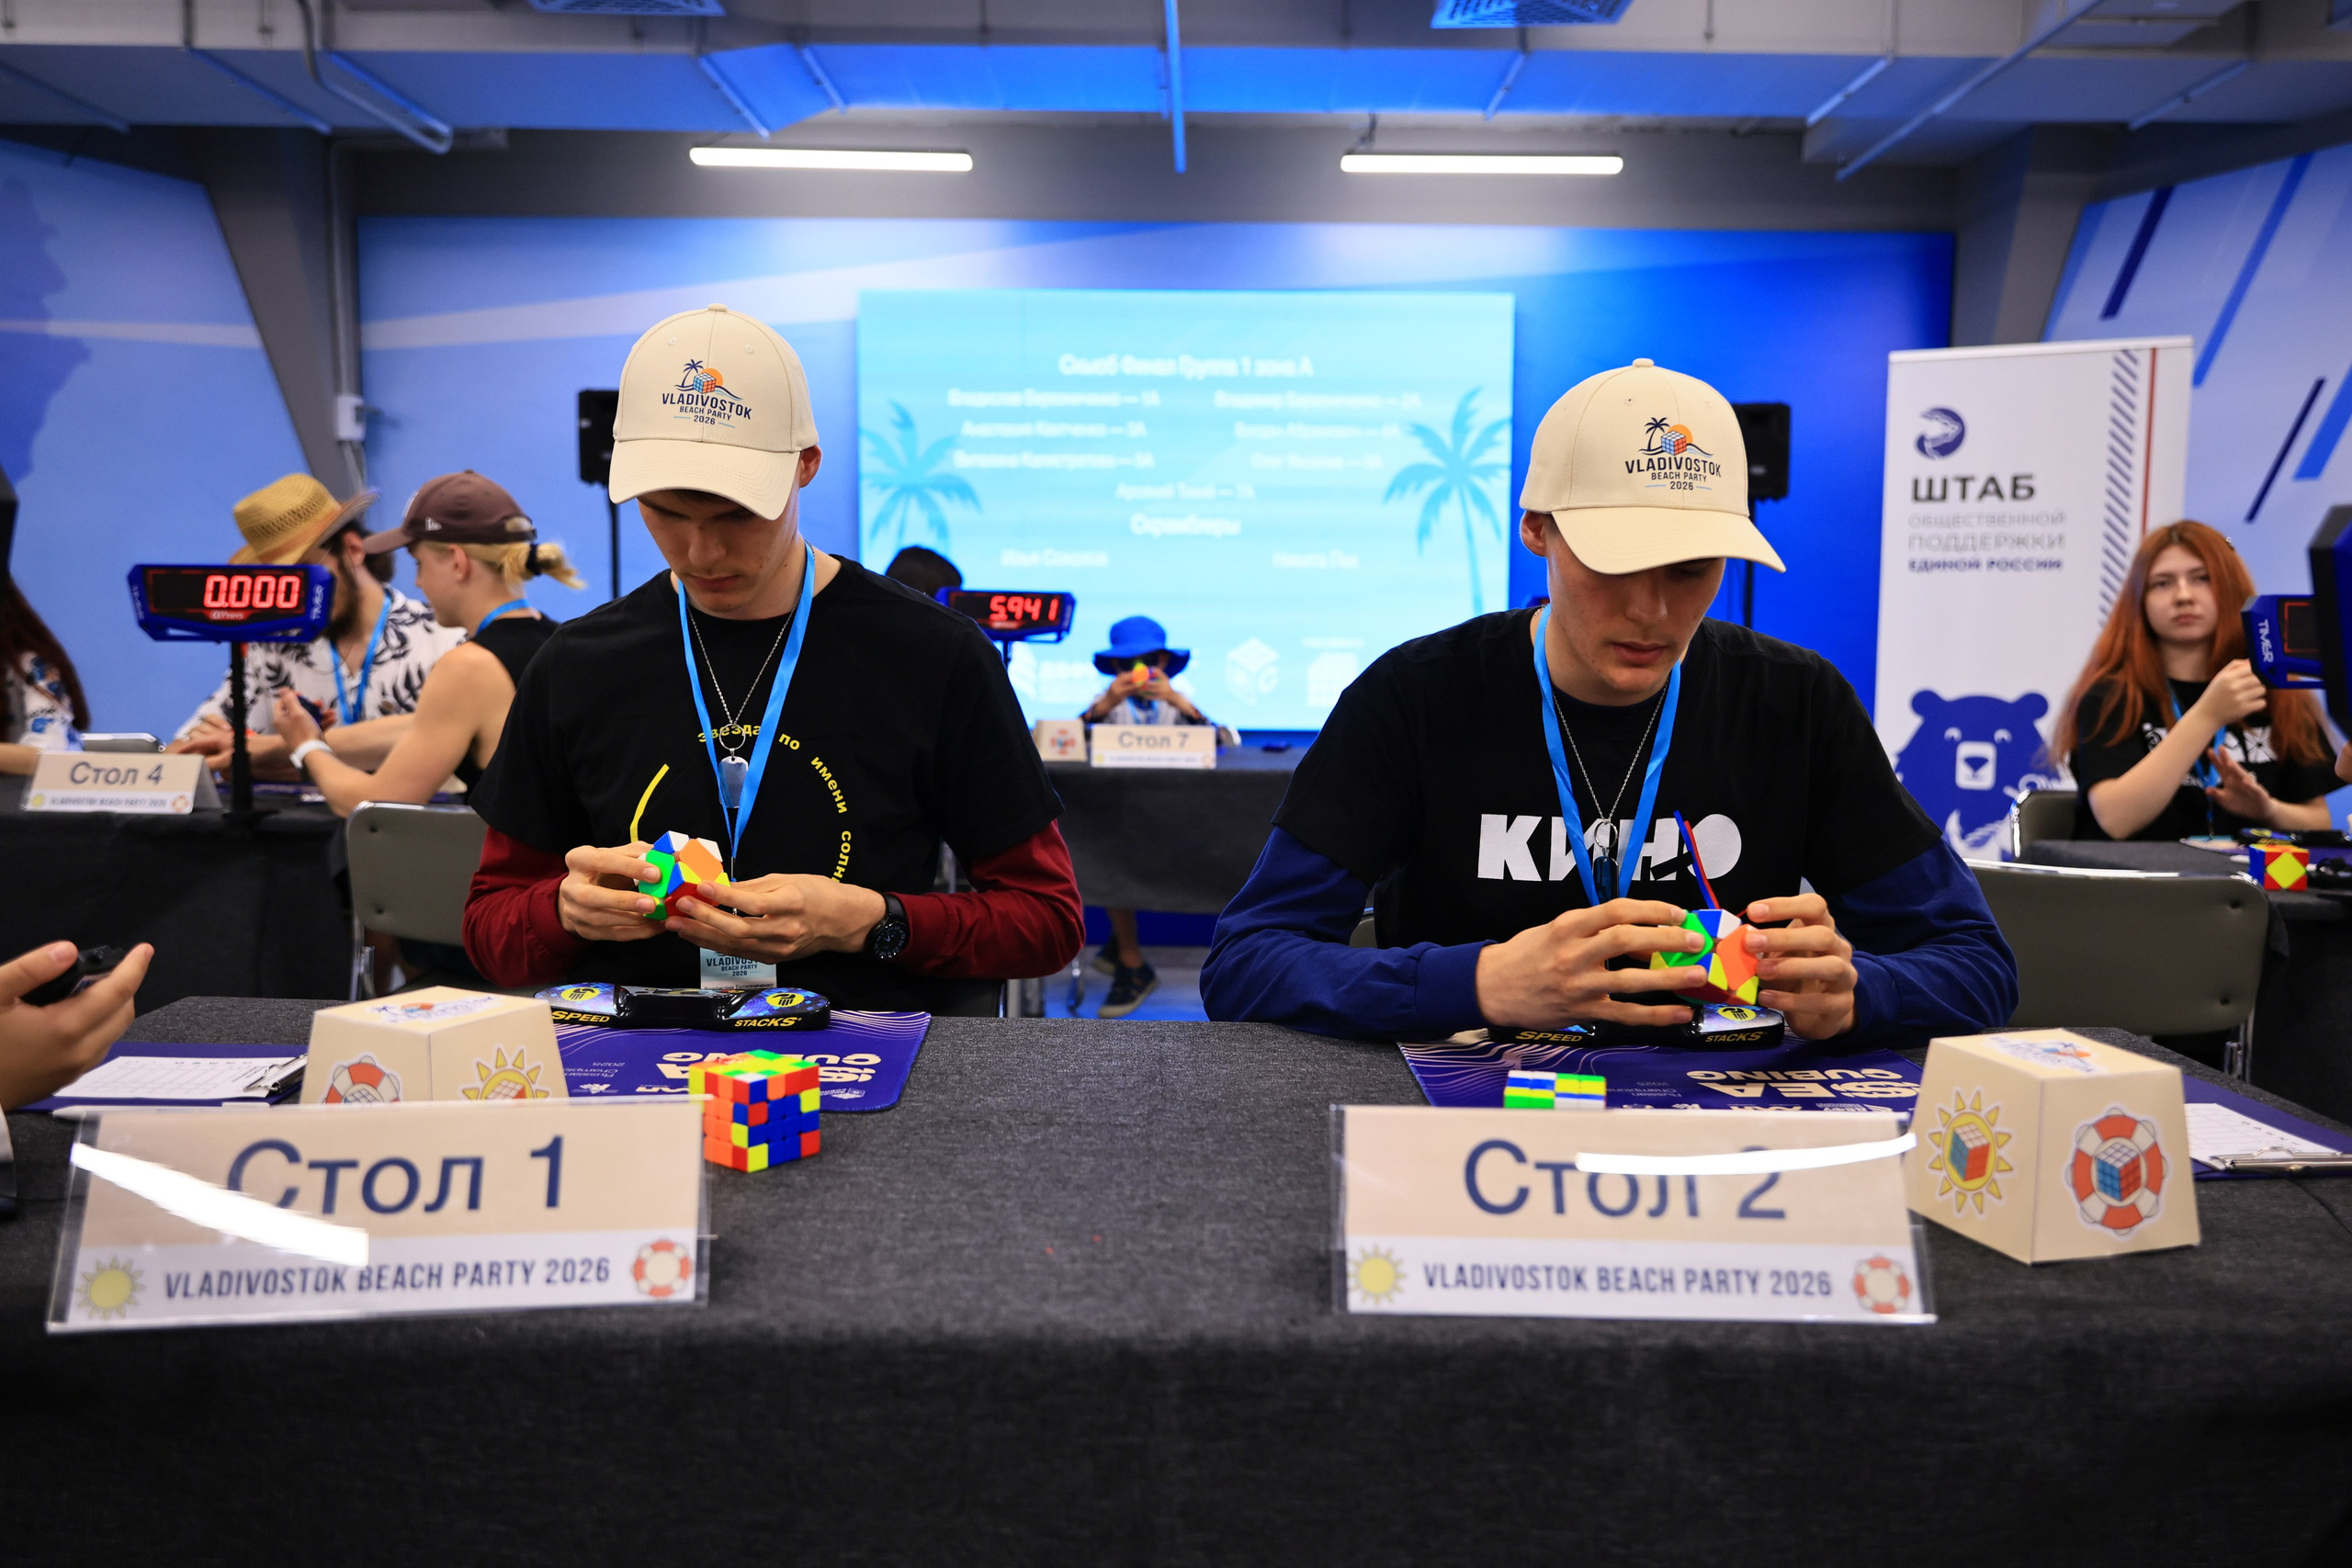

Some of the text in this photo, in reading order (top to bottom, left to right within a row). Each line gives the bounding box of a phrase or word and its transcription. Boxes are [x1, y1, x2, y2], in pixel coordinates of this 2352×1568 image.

[662, 393, 752, 420] VLADIVOSTOK
[707, 409, 731, 421] PARTY
[694, 415, 716, 424] 2026
[1625, 457, 1721, 478] VLADIVOSTOK
[1651, 472, 1707, 482] BEACH PARTY
[1670, 481, 1693, 491] 2026
[1911, 474, 2035, 502] ШТАБ
[1907, 510, 2065, 529] ОБЩЕСТВЕННОЙ
[1908, 532, 2065, 552] ПОДДЕРЖКИ
[1908, 557, 2063, 572] ЕДИНОЙ РОССИИ
[204, 574, 300, 608] 0.000
[2258, 619, 2274, 663] TIMER
[1117, 731, 1190, 749] Стол 7
[70, 761, 164, 785] Стол 4
[697, 724, 761, 743] звезда
[778, 733, 800, 750] по
[810, 756, 848, 814] имени
[1477, 813, 1742, 882] КИНО
[551, 1010, 610, 1022] SPEED
[1516, 1031, 1583, 1043] SPEED
[1686, 1068, 1902, 1080] CUBING
[227, 1134, 564, 1213] Стол 1
[1464, 1137, 1787, 1220] Стол 2
[164, 1257, 610, 1299] VLADIVOSTOK BEACH PARTY 2026
[1423, 1262, 1832, 1298] VLADIVOSTOK BEACH PARTY 2026
